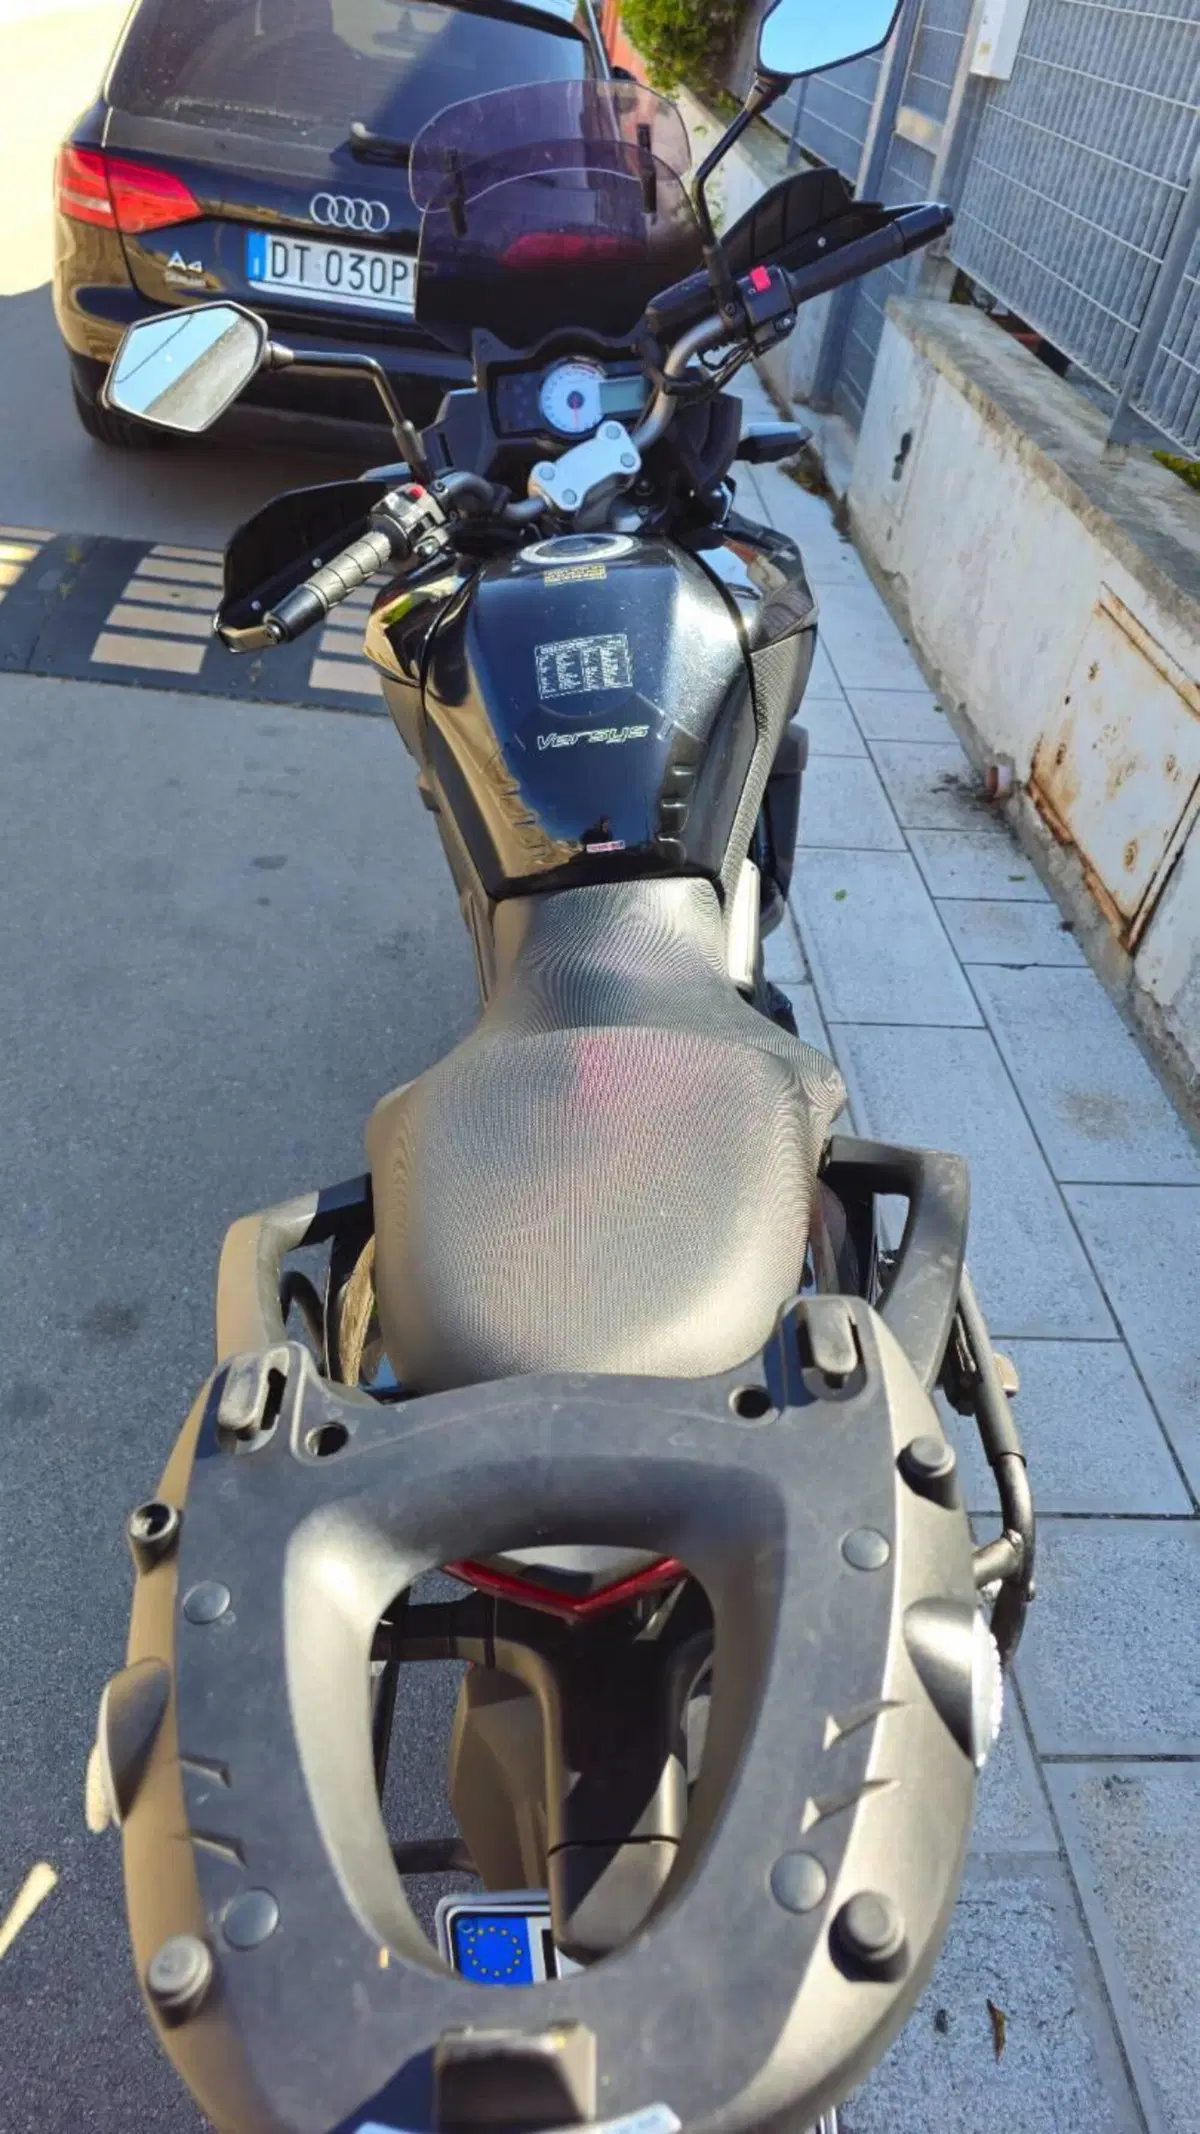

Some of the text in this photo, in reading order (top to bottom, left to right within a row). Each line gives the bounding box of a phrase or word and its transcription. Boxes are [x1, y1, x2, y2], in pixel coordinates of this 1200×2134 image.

[167, 250, 202, 273] A4
[271, 240, 418, 297] DT 030P
[537, 724, 650, 751] Versys
